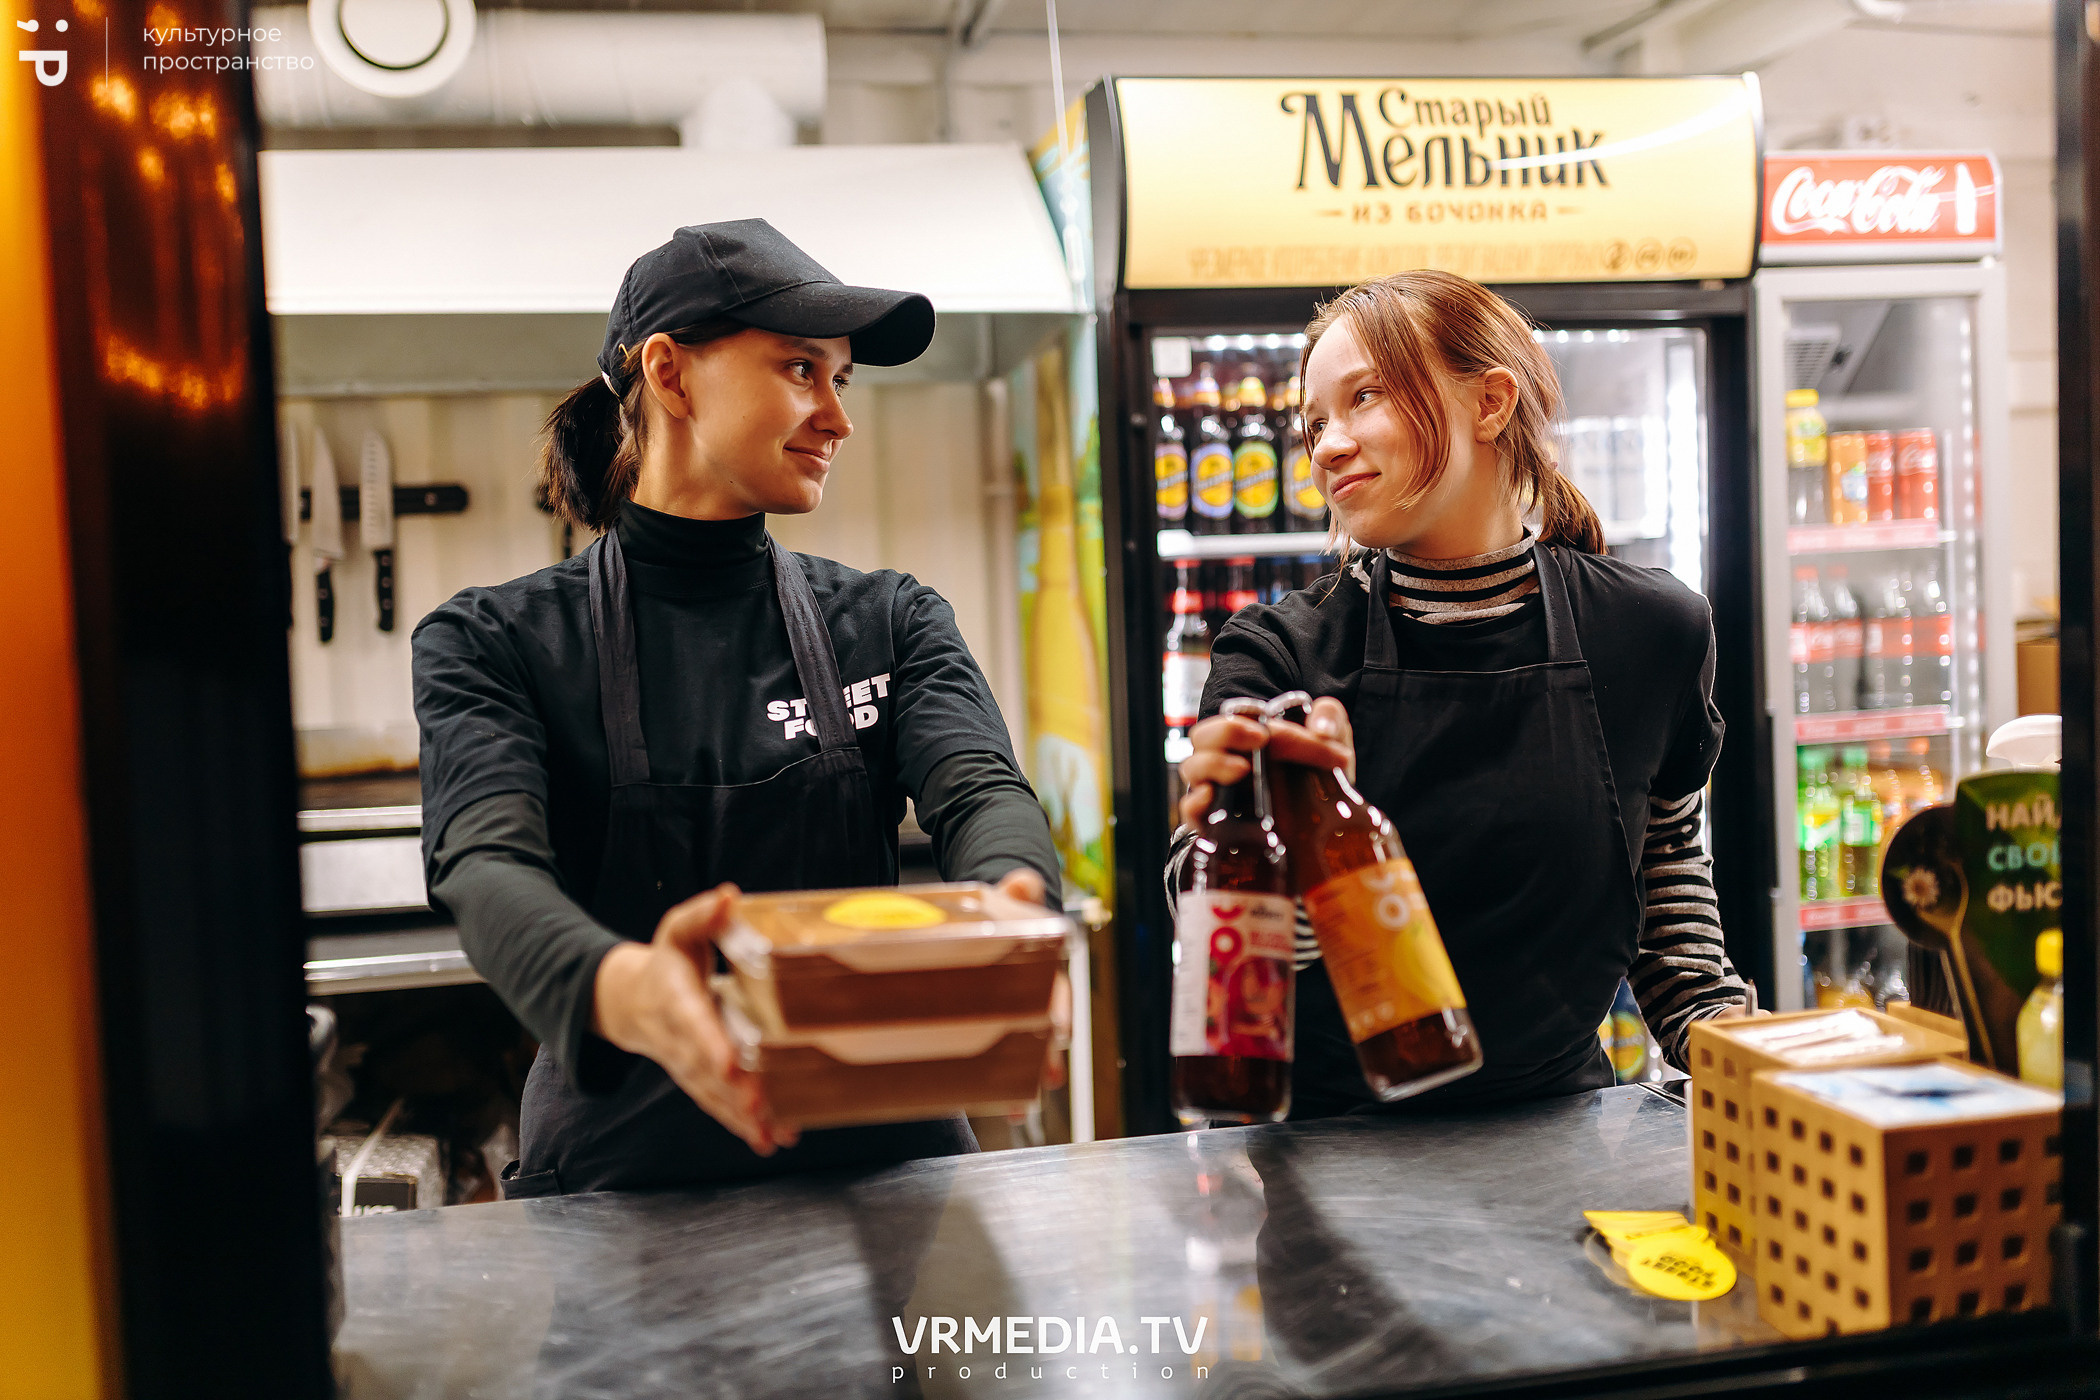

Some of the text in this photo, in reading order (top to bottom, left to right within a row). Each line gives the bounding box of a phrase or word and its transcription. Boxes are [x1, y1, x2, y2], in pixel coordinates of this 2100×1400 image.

[1378, 87, 1553, 138] Старый
[1280, 92, 1610, 191] Мельник
[766, 672, 891, 722] STET
[784, 704, 879, 740] FD
[1985, 791, 2062, 832] НАЙ
